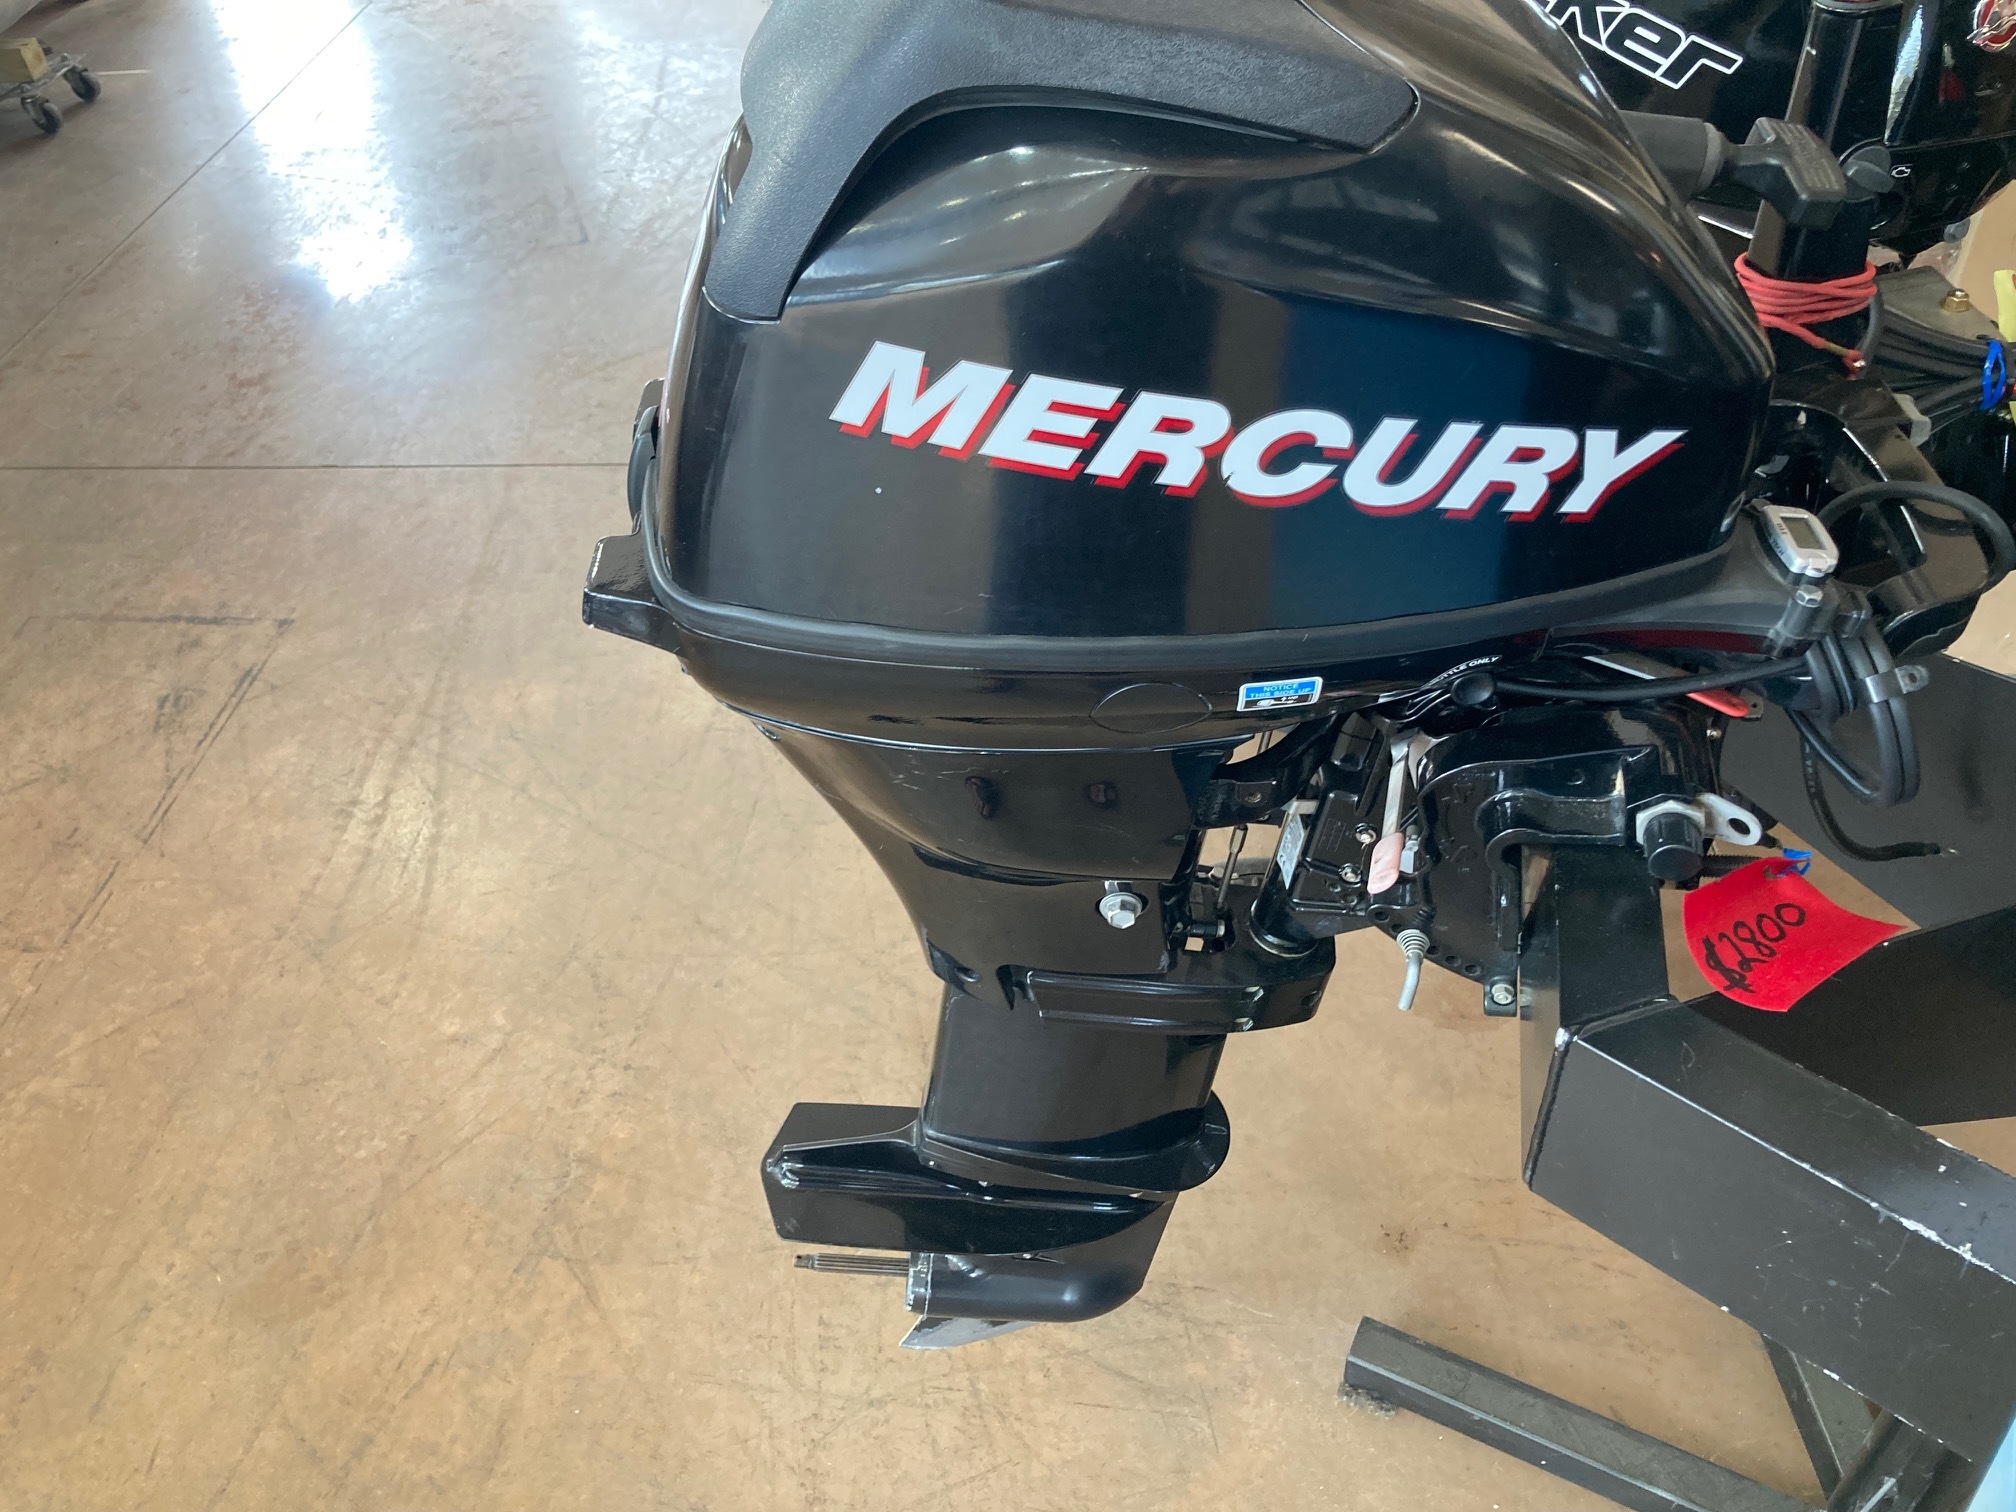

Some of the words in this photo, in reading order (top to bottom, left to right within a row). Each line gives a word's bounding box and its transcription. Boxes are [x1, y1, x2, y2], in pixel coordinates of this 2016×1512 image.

[829, 340, 1686, 523] MERCURY
[1468, 656, 1499, 667] ONLY
[1263, 683, 1299, 692] NOTICE
[1274, 689, 1295, 697] SIDE
